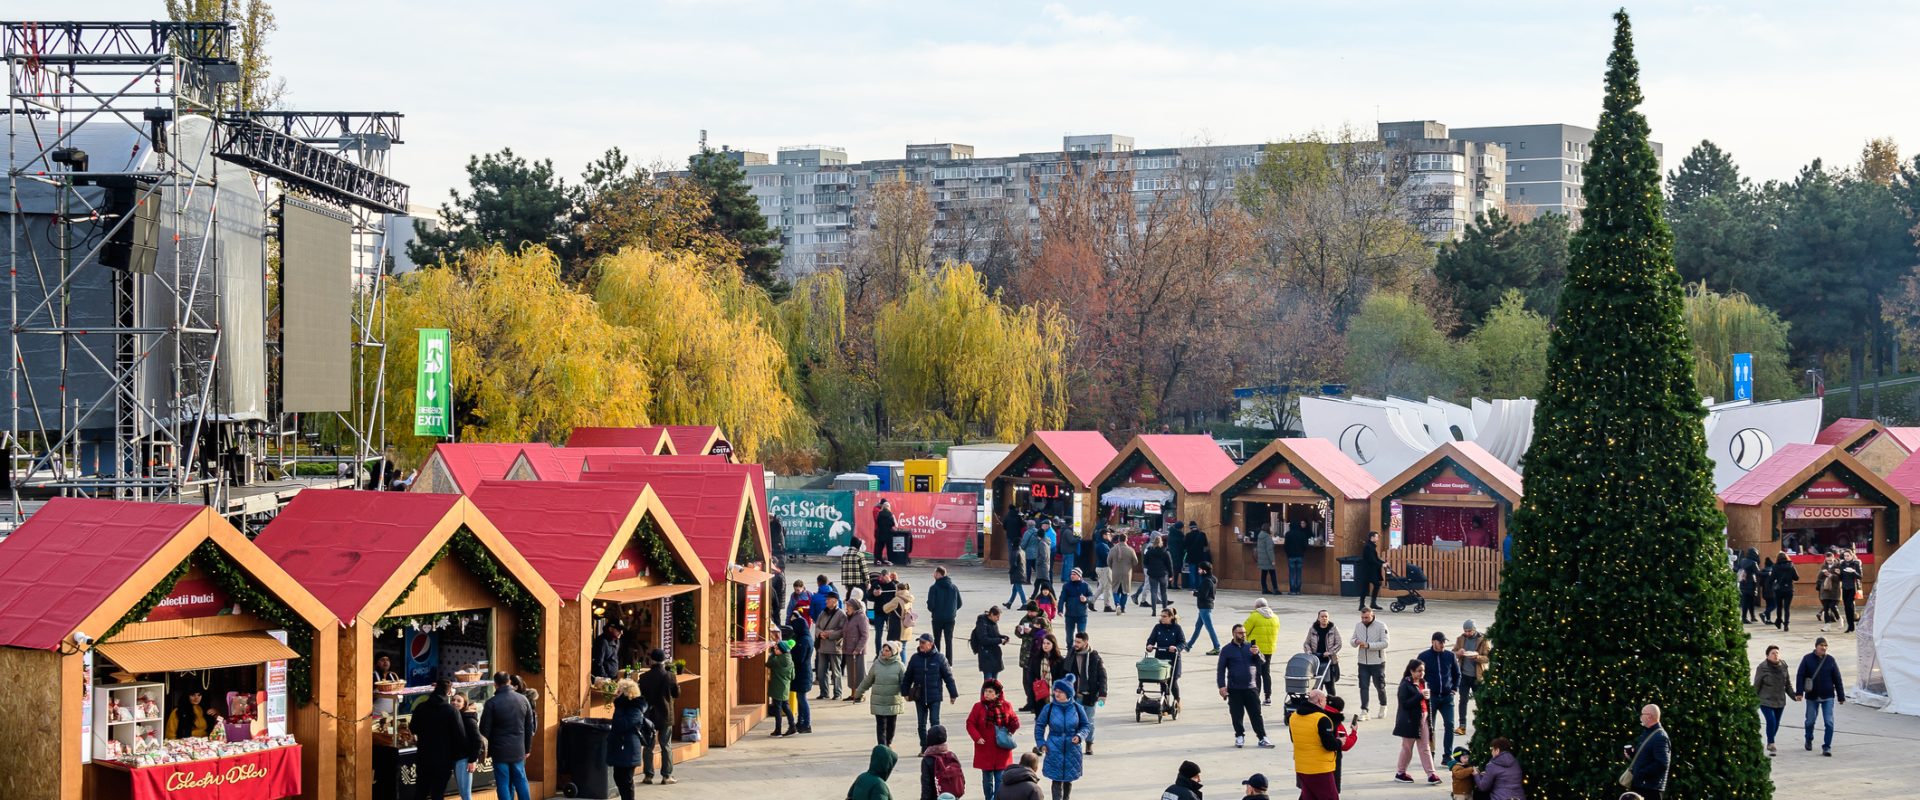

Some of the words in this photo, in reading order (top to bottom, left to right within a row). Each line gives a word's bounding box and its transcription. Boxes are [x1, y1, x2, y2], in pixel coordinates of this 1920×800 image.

[417, 415, 443, 426] EXIT
[799, 500, 842, 521] Side
[781, 520, 825, 529] RISTMAS
[918, 515, 947, 530] Side
[617, 559, 629, 569] BAR
[158, 595, 189, 607] olecții
[190, 592, 214, 604] Dulci
